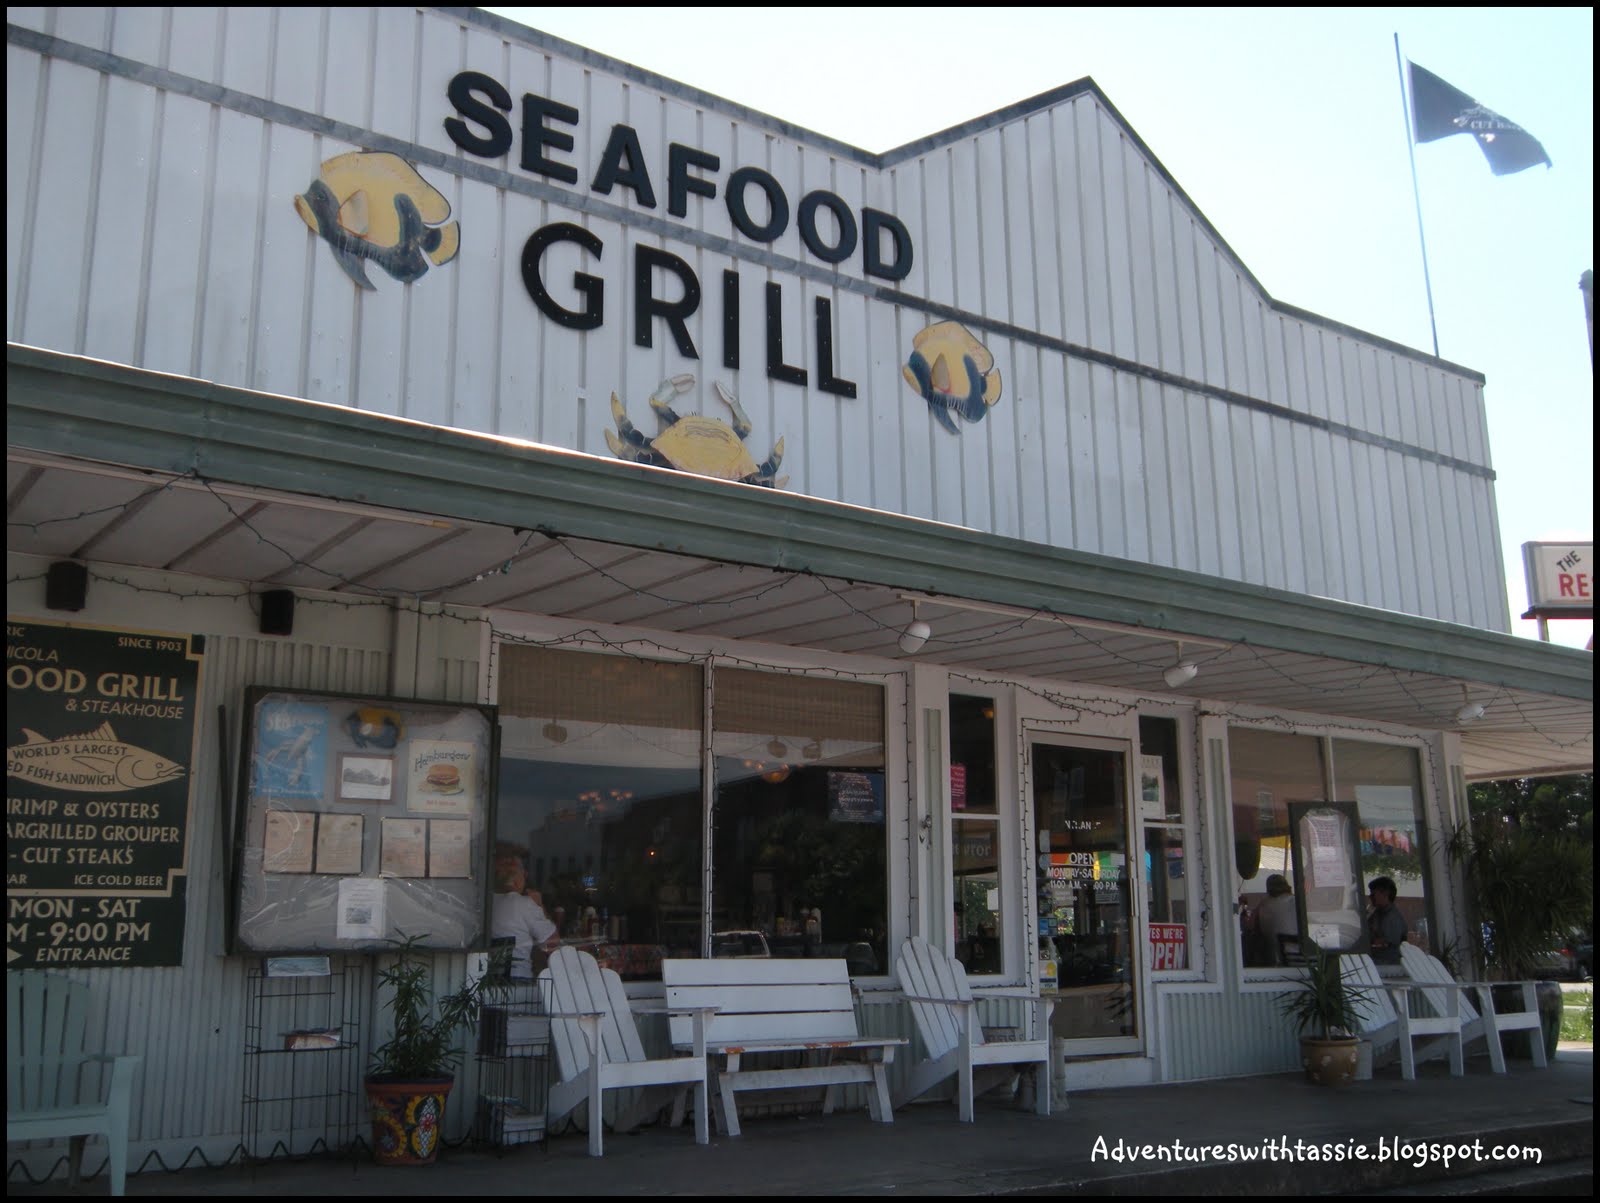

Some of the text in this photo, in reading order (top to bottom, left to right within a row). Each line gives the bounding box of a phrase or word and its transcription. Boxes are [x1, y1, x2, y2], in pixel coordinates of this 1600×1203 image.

[444, 71, 913, 281] SEAFOOD
[521, 222, 857, 399] GRILL
[1556, 550, 1581, 572] THE
[118, 636, 182, 652] SINCE 1903
[7, 664, 184, 702] OOD GRILL
[65, 698, 185, 720] & STEAKHOUSE
[13, 744, 128, 760] WORLD'S LARGEST
[26, 765, 54, 781] FISH
[56, 772, 116, 786] SANDWICH
[64, 802, 79, 816] &
[85, 802, 161, 820] OYSTERS
[102, 825, 180, 843] GROUPER
[22, 847, 62, 864] CUT
[1069, 852, 1096, 865] OPEN
[7, 873, 164, 888] AR ICE COLD BEER
[10, 898, 75, 919] MON
[97, 899, 142, 919] SAT
[115, 922, 152, 942] PM
[1163, 928, 1184, 939] WE'RE
[36, 946, 132, 963] ENTRANCE
